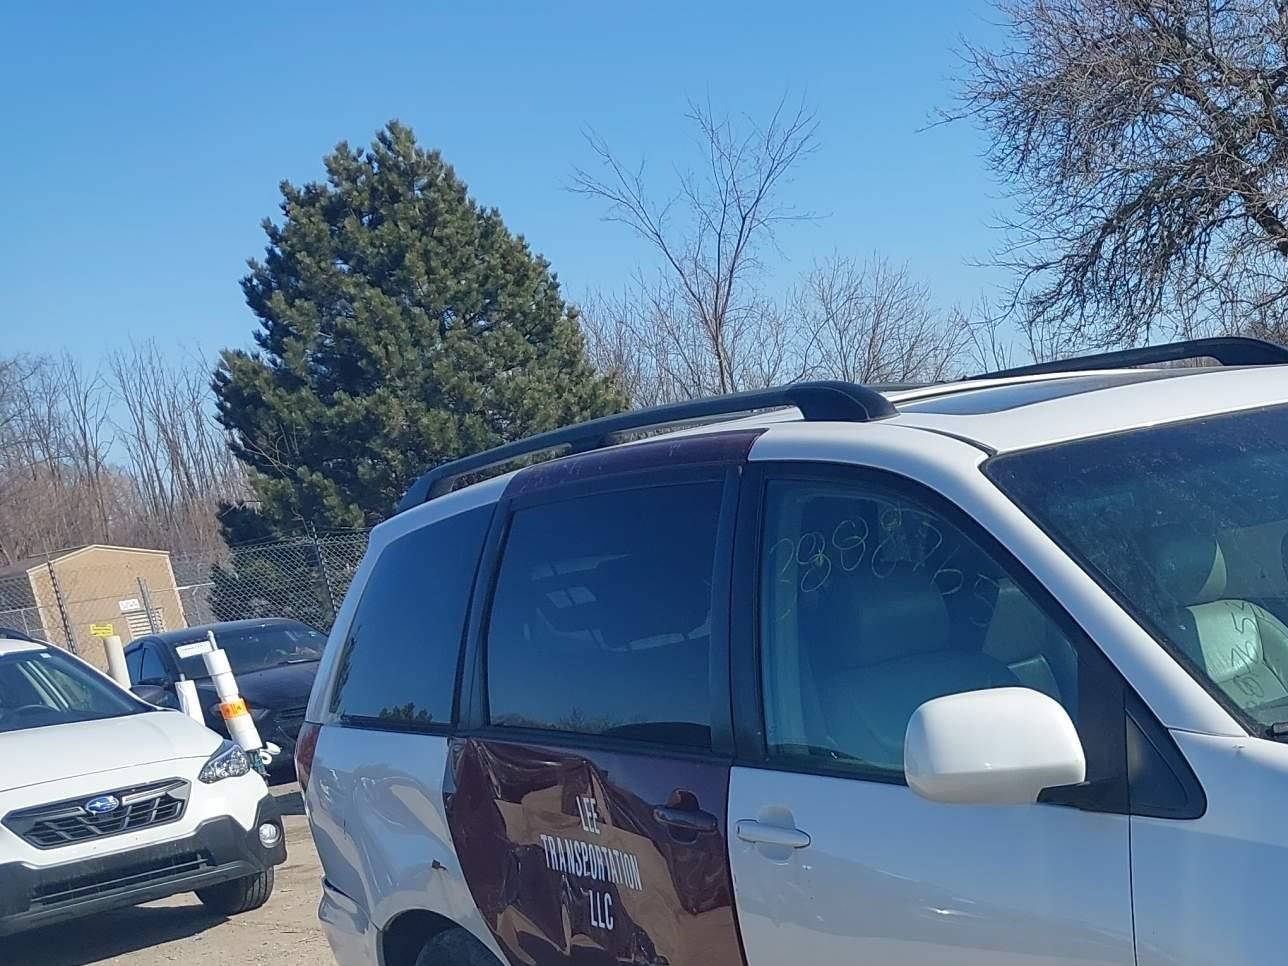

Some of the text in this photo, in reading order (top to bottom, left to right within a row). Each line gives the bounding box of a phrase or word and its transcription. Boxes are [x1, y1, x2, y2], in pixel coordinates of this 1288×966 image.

[576, 795, 601, 834] LEE
[539, 833, 643, 891] TRANSPORTATION
[584, 888, 614, 930] LLC
